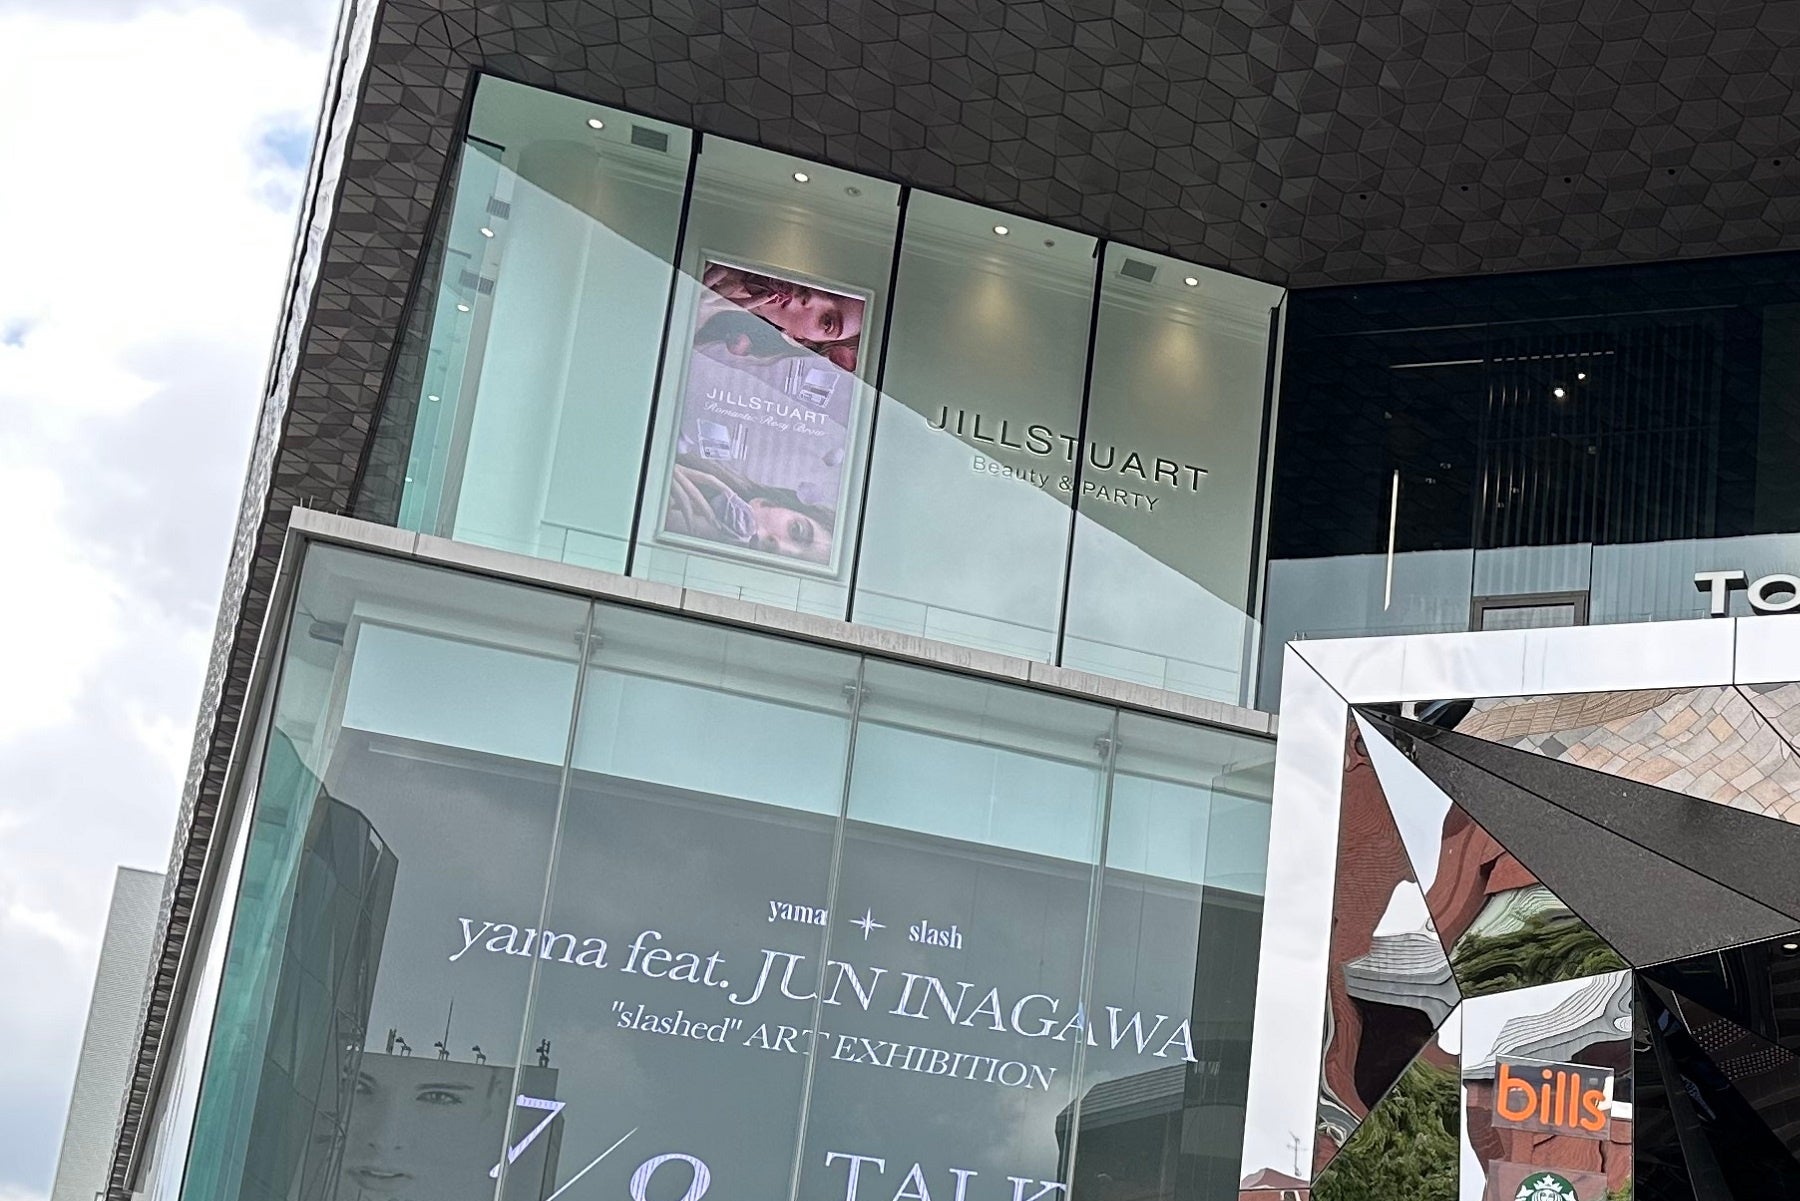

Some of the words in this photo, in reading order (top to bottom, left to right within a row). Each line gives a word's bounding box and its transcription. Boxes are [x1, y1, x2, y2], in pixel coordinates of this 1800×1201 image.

[706, 387, 830, 425] JILLSTUART
[926, 405, 1209, 492] JILLSTUART
[972, 454, 1049, 488] Beauty
[1058, 475, 1073, 491] &
[1082, 480, 1160, 512] PARTY
[768, 898, 828, 927] yama
[908, 920, 963, 951] slash
[448, 916, 609, 971] yama
[620, 929, 731, 991] feat.
[728, 947, 895, 1016] JUN
[889, 971, 1198, 1063] INAGAWA
[610, 1000, 742, 1046] "slashed"
[743, 1024, 830, 1058] ART
[832, 1034, 1056, 1091] EXHIBITION
[1497, 1063, 1606, 1131] bills
